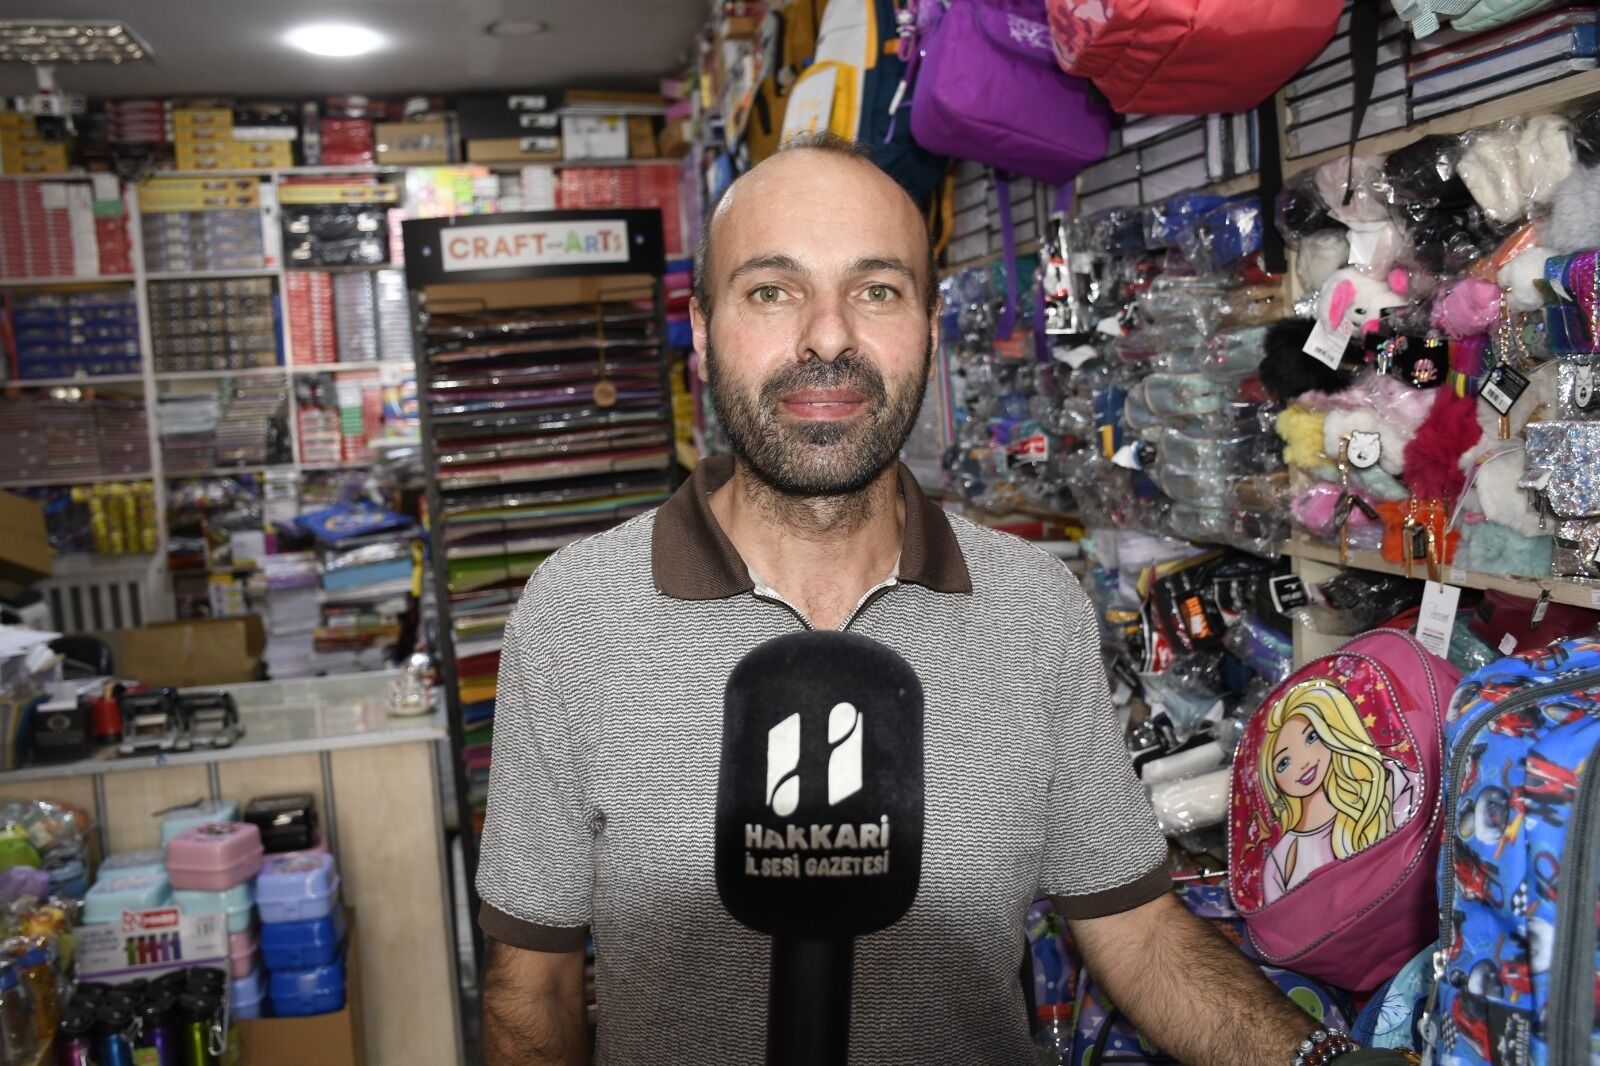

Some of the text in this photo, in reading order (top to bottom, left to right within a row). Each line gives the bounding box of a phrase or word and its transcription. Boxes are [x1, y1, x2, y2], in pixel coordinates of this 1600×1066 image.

[448, 233, 548, 261] CRAFT
[744, 813, 890, 849] HAKKARİ
[744, 850, 890, 878] İL SESİ GAZETESİ
